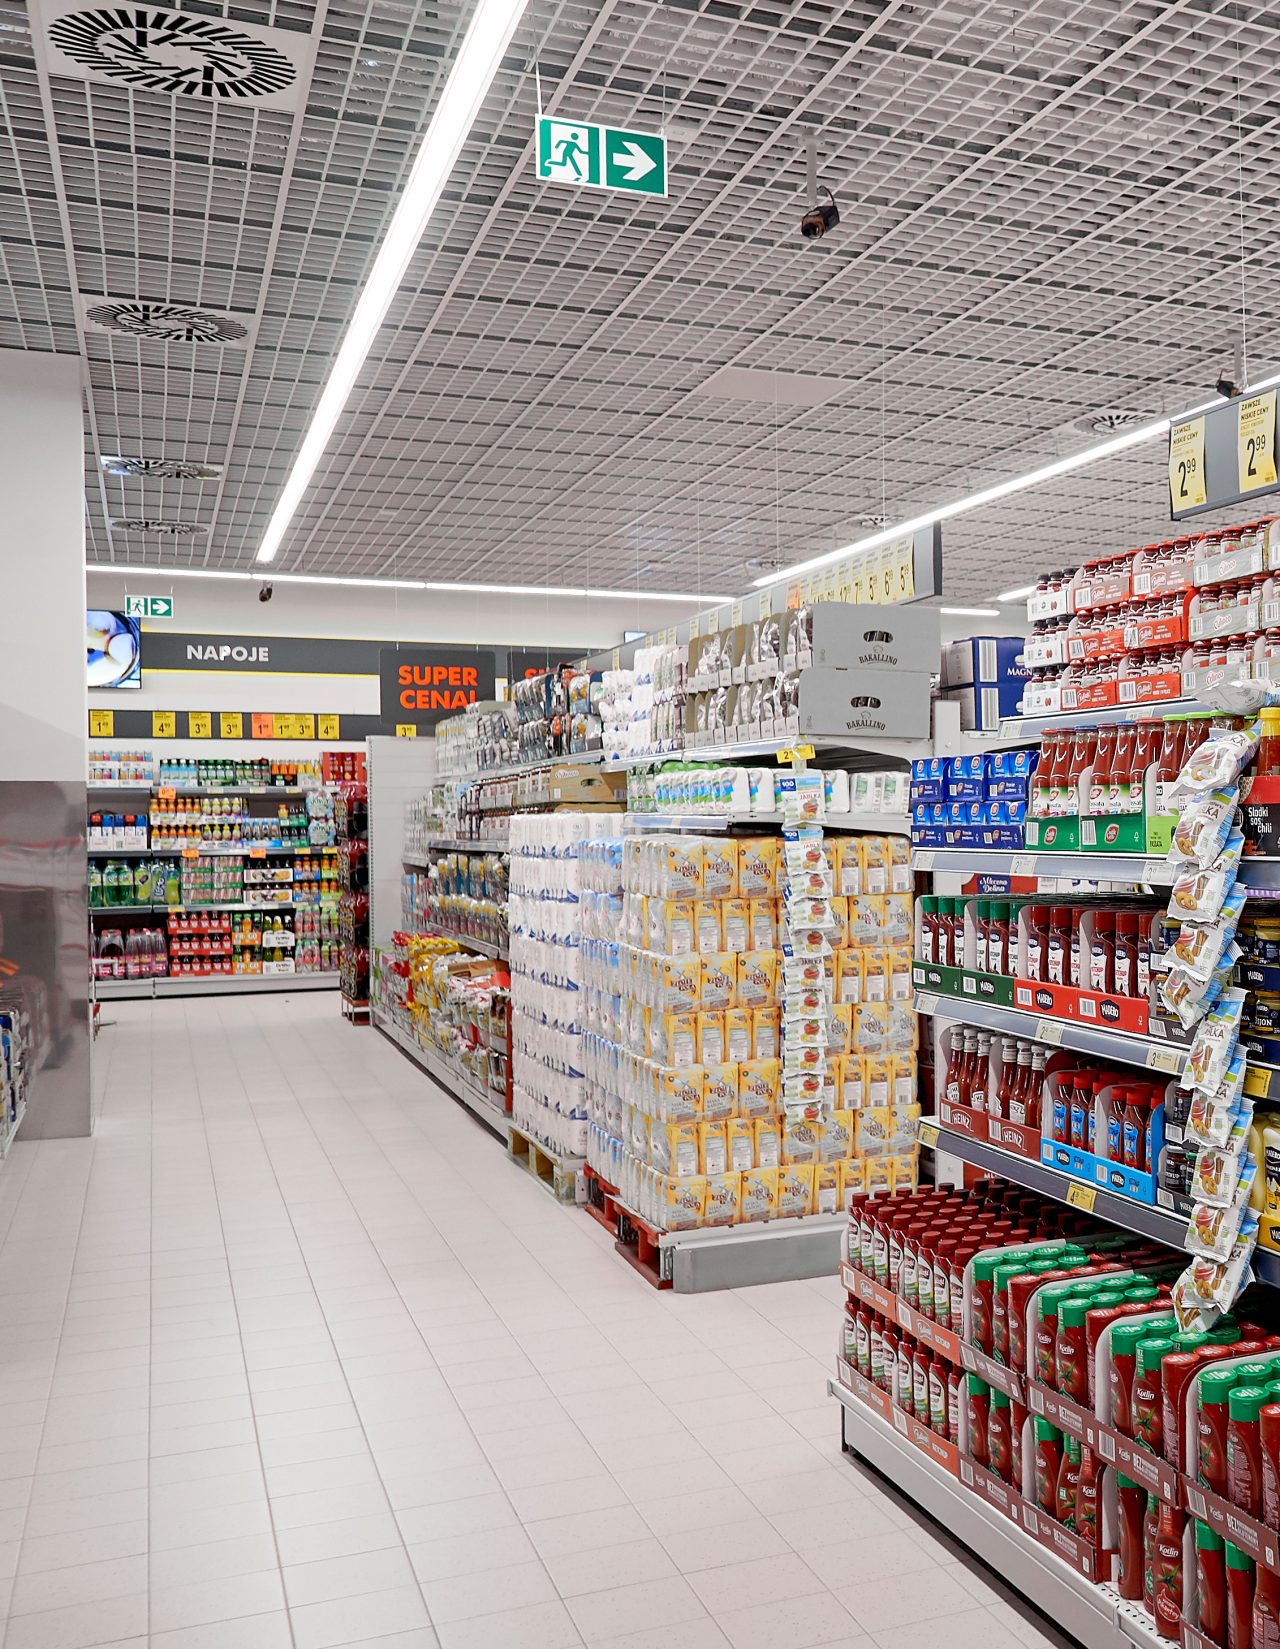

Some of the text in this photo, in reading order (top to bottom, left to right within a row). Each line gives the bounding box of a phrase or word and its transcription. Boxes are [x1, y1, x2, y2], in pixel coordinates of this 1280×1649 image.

[1256, 406, 1269, 416] CENY
[186, 644, 270, 663] NAPOJE
[858, 652, 898, 666] BAKALLINO
[398, 665, 478, 686] SUPER
[846, 719, 886, 732] BAKALLINO
[1250, 816, 1262, 826] sos
[1257, 821, 1272, 834] chili
[951, 1113, 972, 1128] HEINZ
[1002, 1132, 1023, 1148] HEINZ
[1137, 1387, 1155, 1400] Kotlin
[1159, 1544, 1180, 1558] Kotlin
